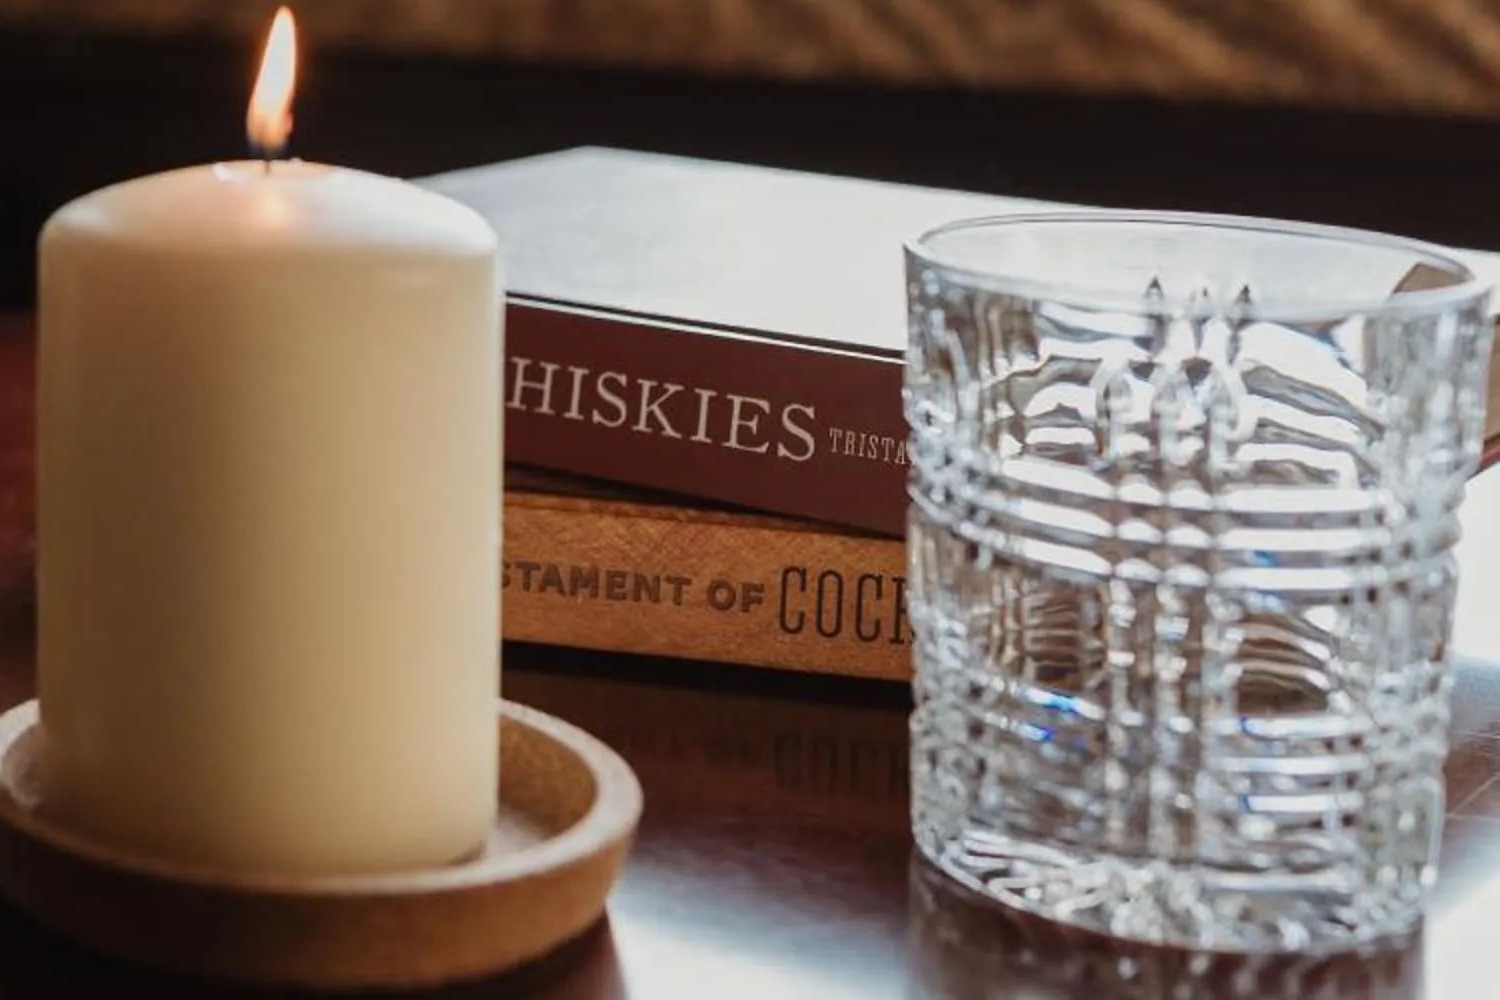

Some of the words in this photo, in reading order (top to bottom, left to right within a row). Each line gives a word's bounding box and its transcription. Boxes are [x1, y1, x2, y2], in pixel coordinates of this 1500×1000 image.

[505, 355, 817, 462] HISKIES
[829, 426, 907, 465] TRISTA
[705, 577, 767, 614] OF
